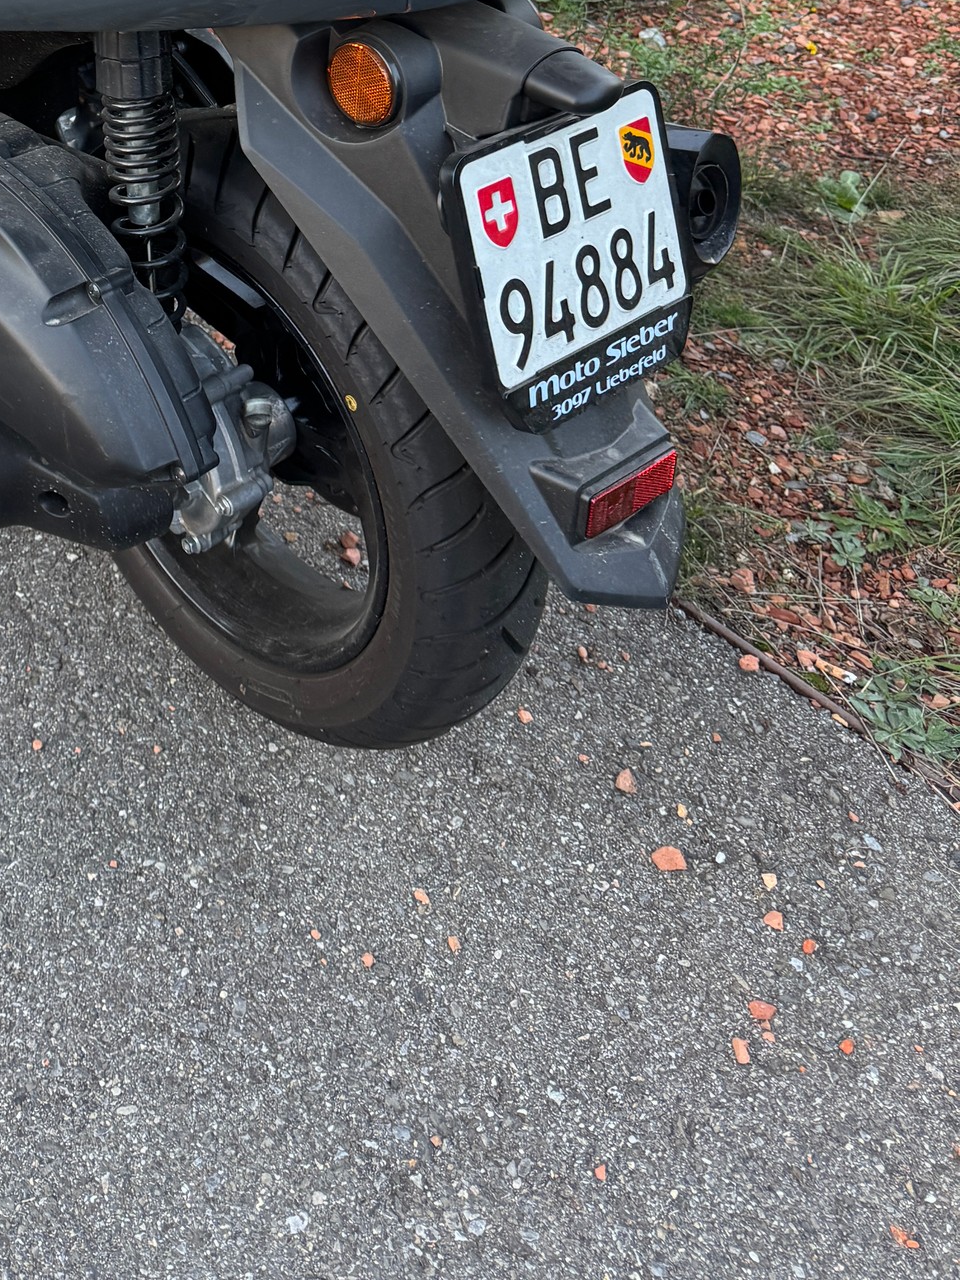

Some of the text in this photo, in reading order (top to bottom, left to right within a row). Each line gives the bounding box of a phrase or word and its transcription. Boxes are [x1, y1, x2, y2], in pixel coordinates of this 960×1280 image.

[528, 127, 611, 239] BE
[499, 211, 675, 372] 94884
[551, 344, 667, 421] 3097 Liebefeld
[607, 312, 678, 367] Sieber
